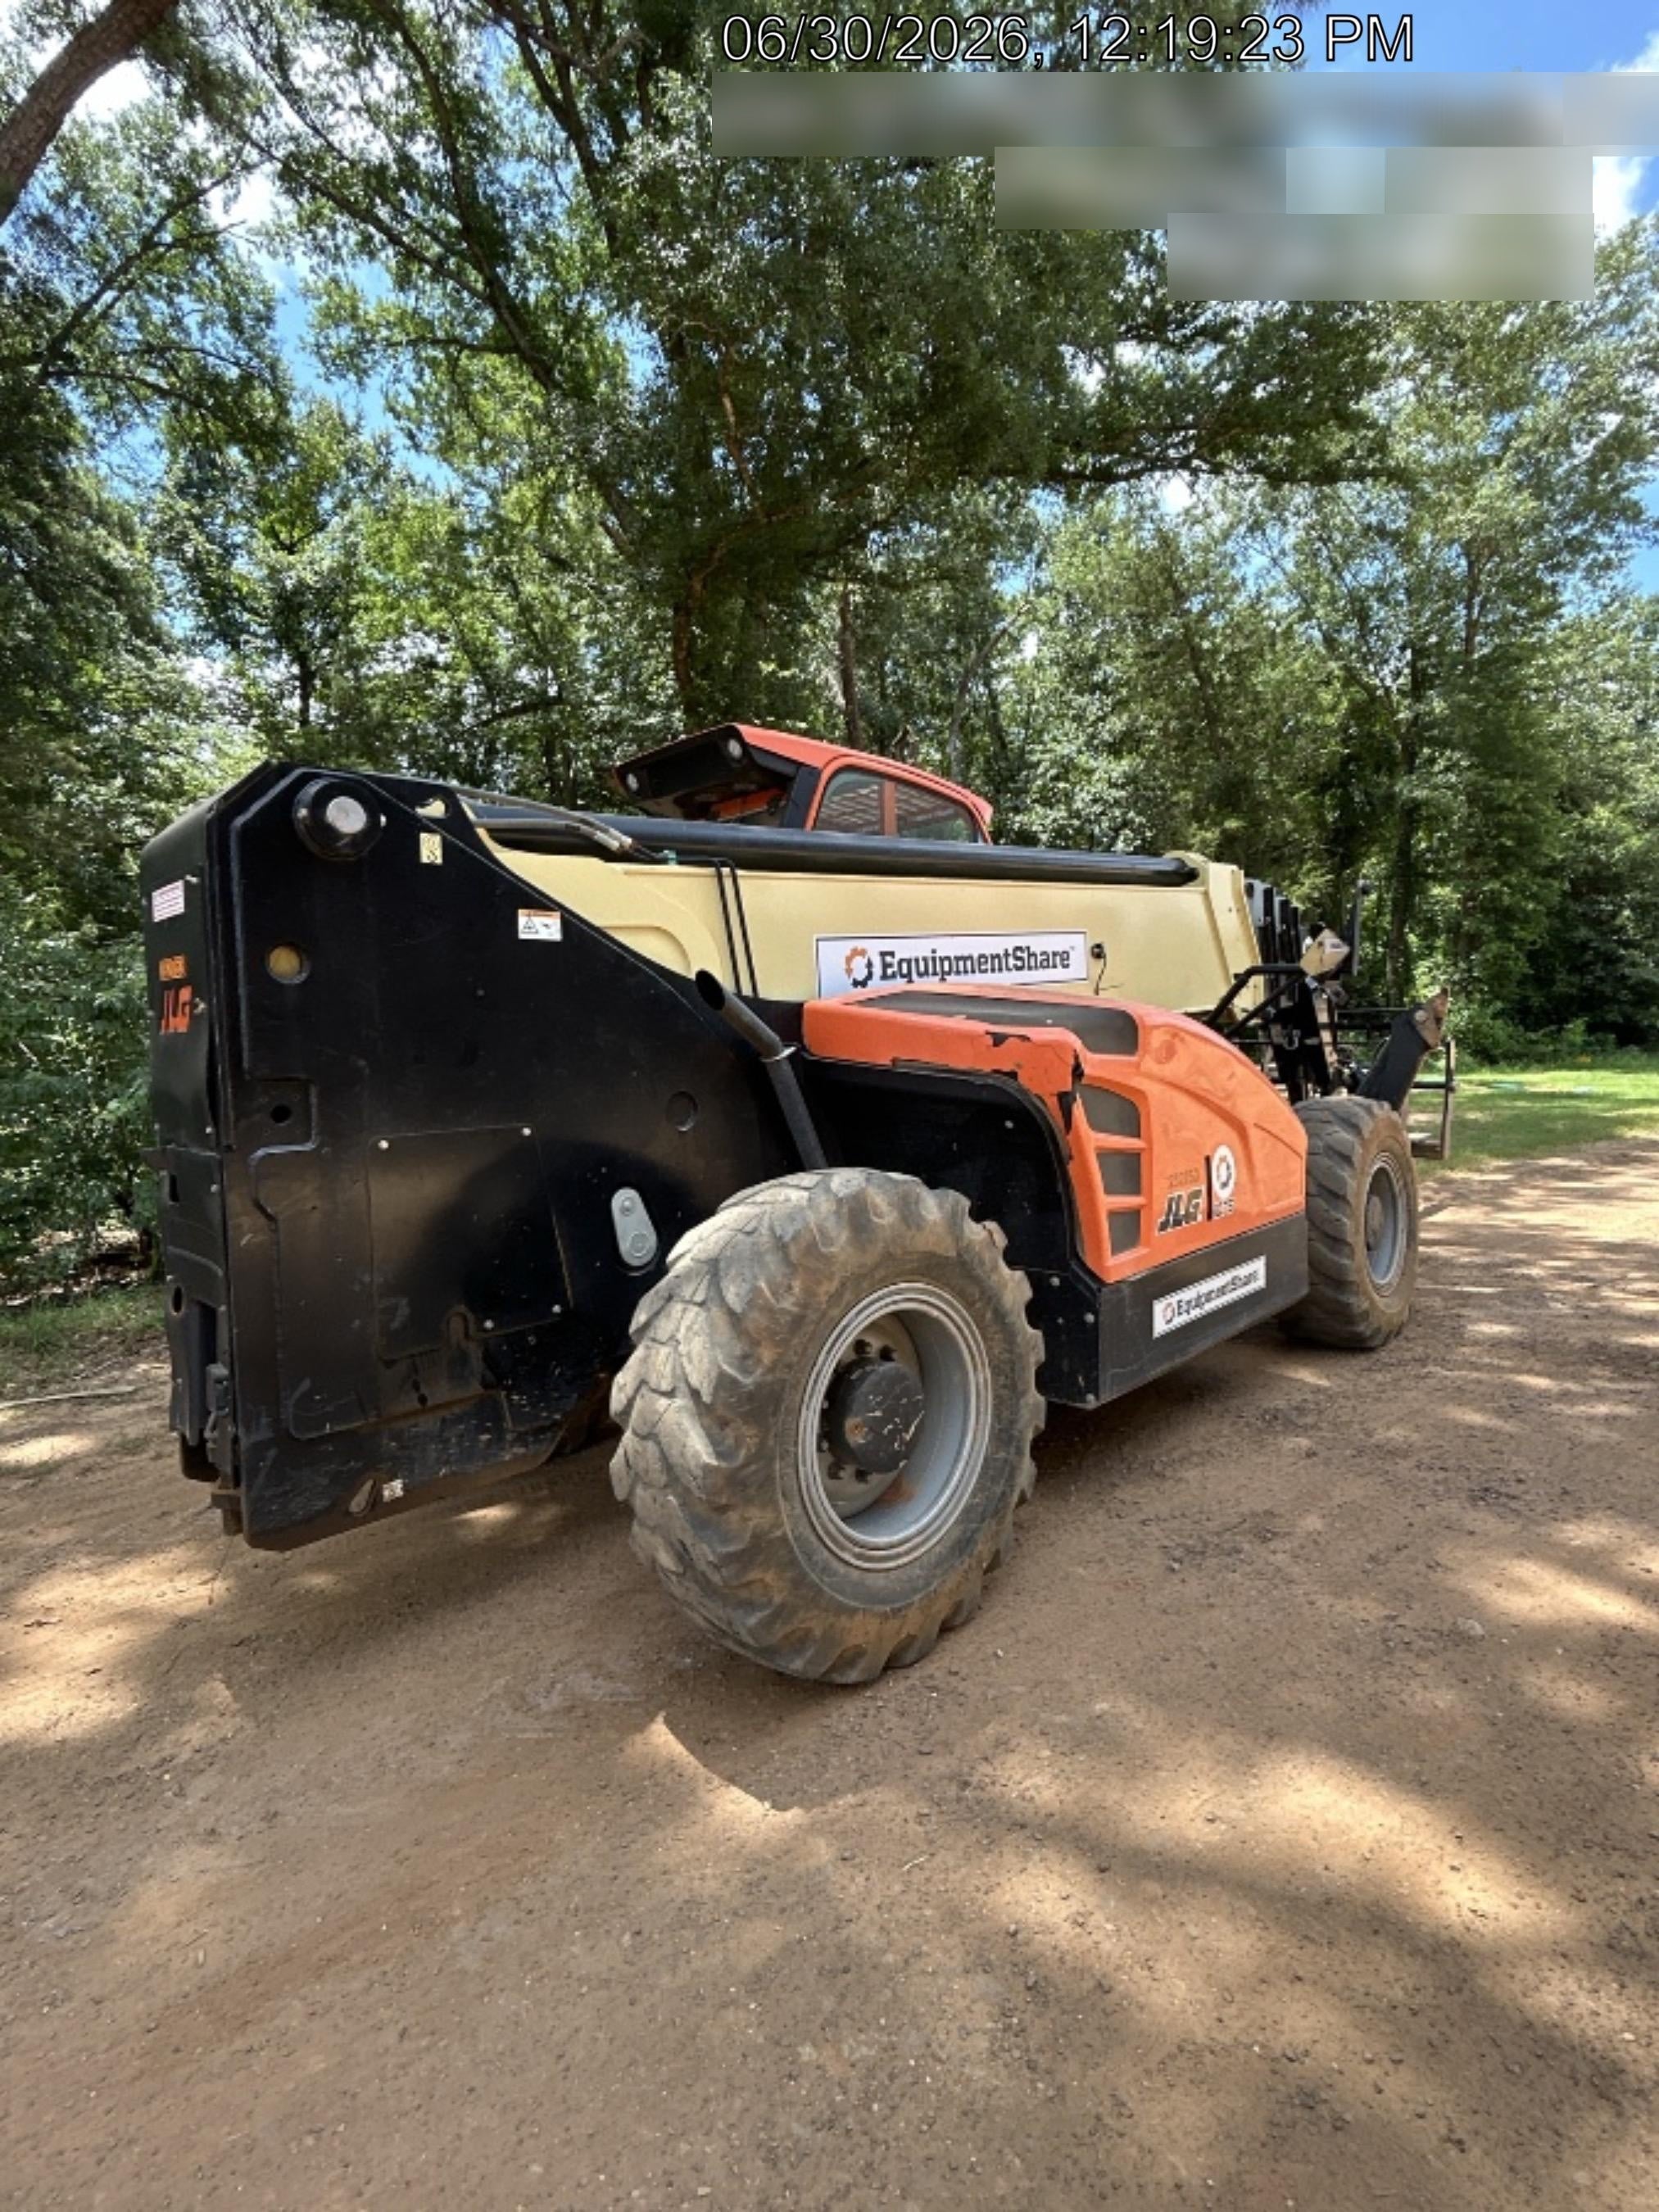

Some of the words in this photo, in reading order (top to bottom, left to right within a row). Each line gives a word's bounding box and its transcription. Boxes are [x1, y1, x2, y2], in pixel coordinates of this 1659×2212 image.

[878, 945, 1071, 983] EquipmentShare
[159, 986, 193, 1035] JLG
[1157, 1187, 1203, 1235] JLG
